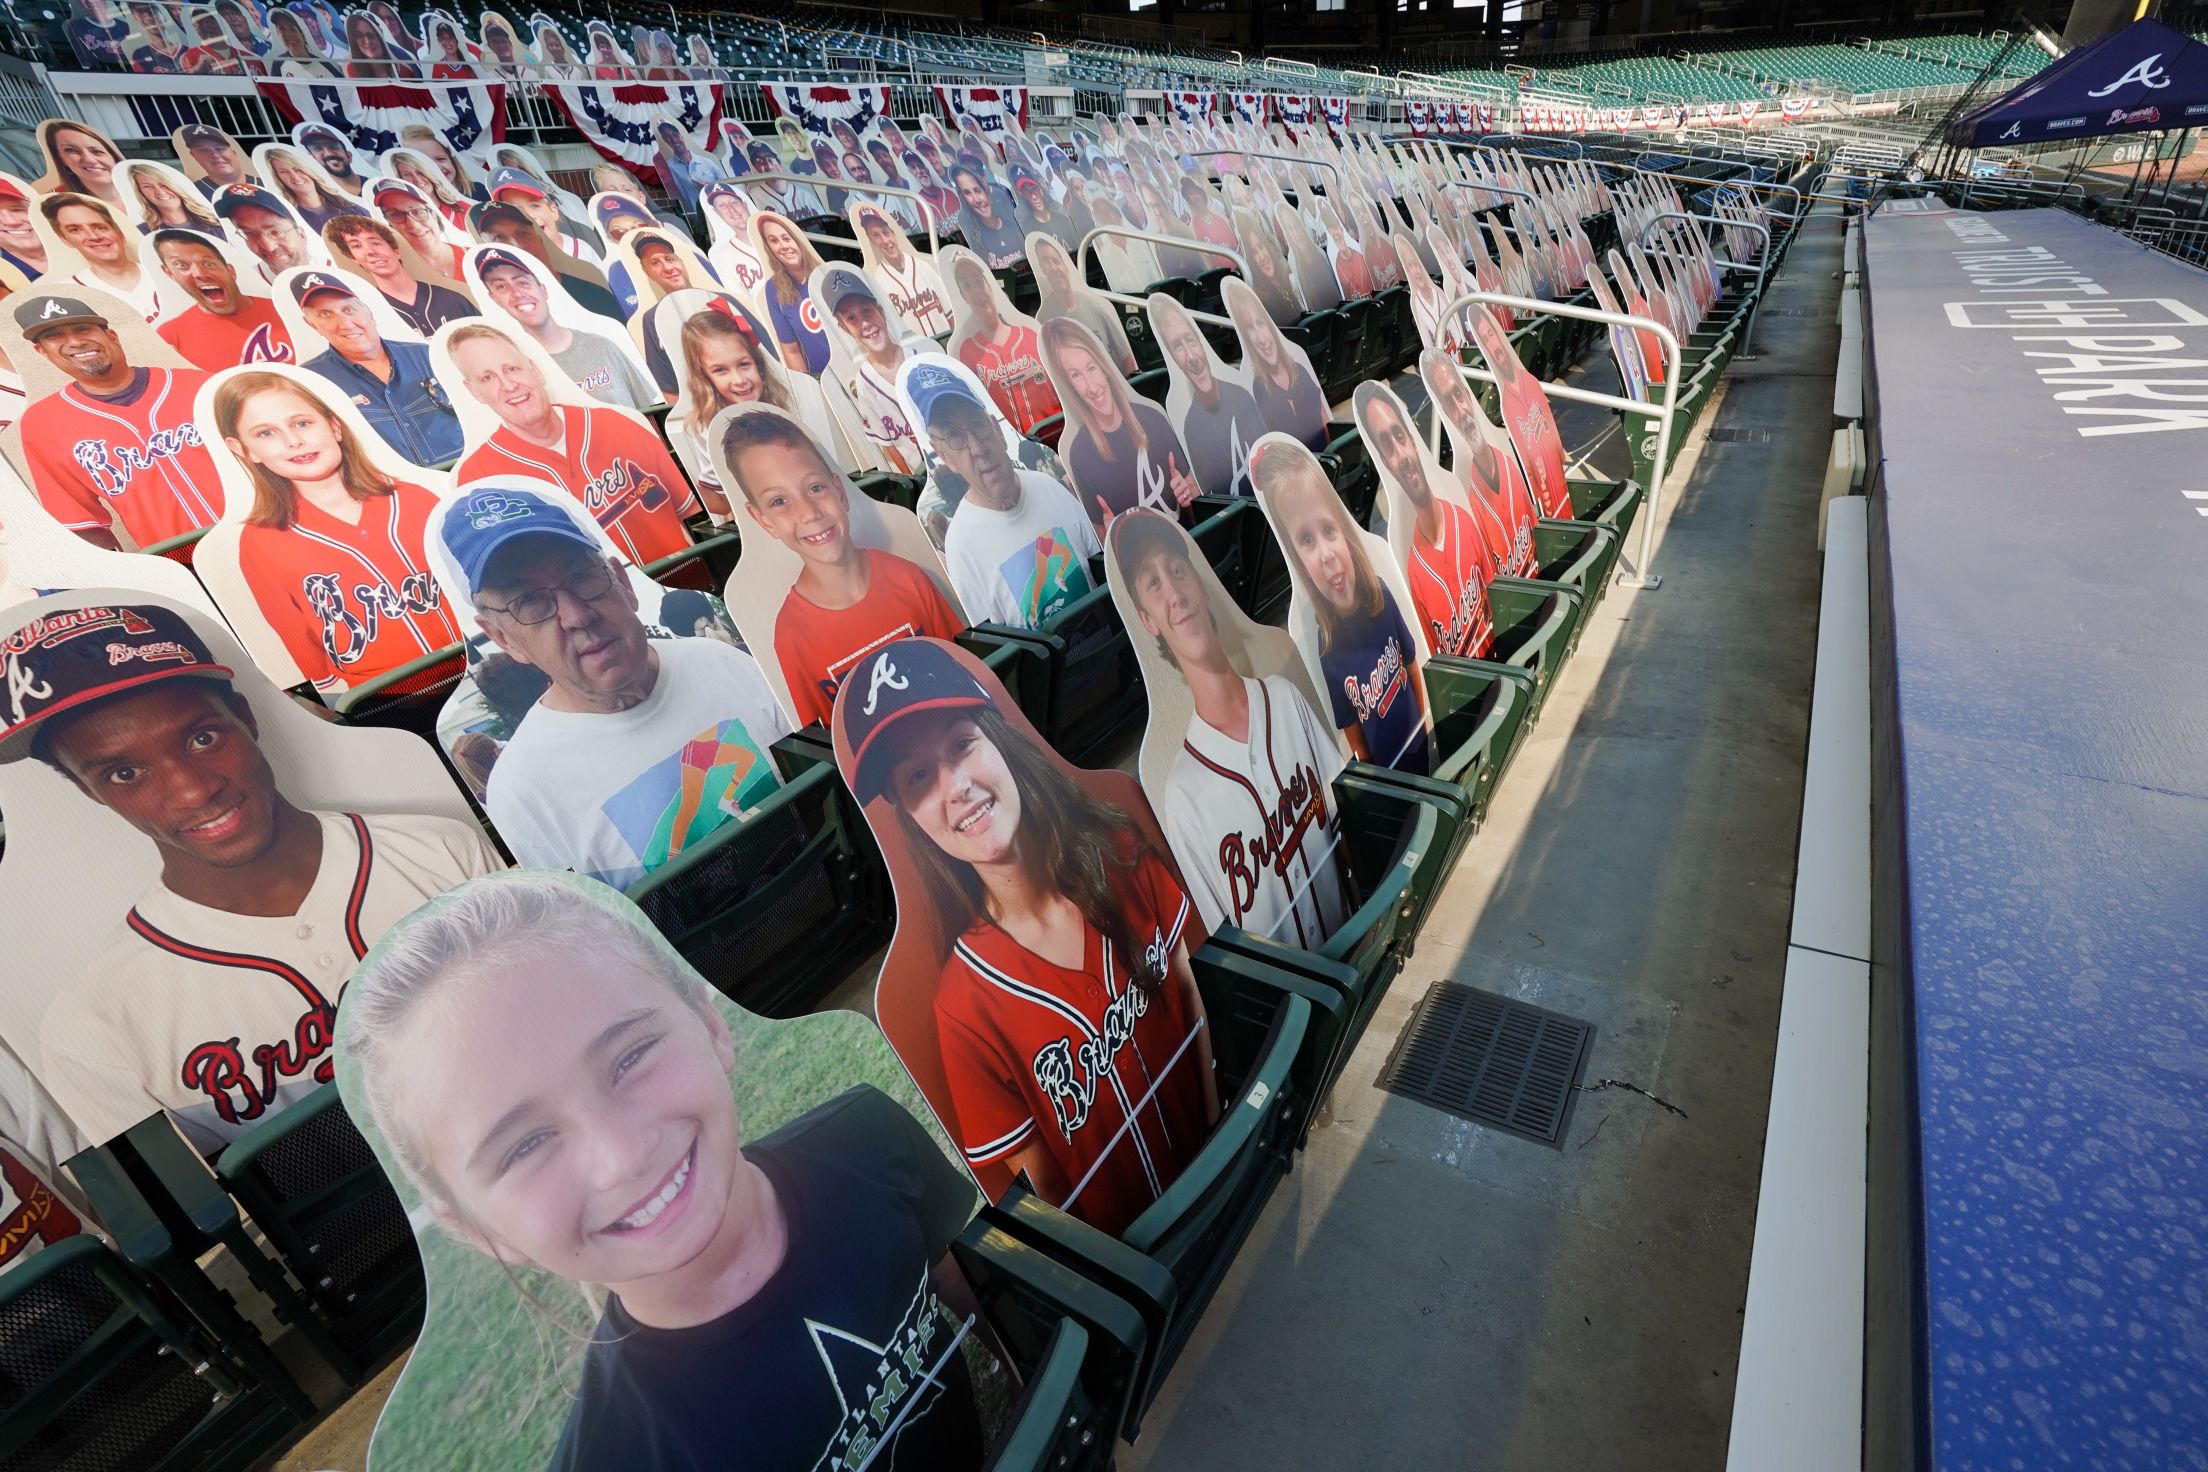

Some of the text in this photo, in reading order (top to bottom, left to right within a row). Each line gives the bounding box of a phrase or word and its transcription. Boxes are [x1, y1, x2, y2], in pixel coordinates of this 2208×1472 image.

[2049, 118, 2085, 129] BRAVES.COM
[1952, 246, 2110, 295] TRUIST
[105, 642, 178, 666] Braves
[1344, 636, 1400, 724] Braves
[863, 652, 909, 716] A
[1219, 762, 1308, 930] Braves
